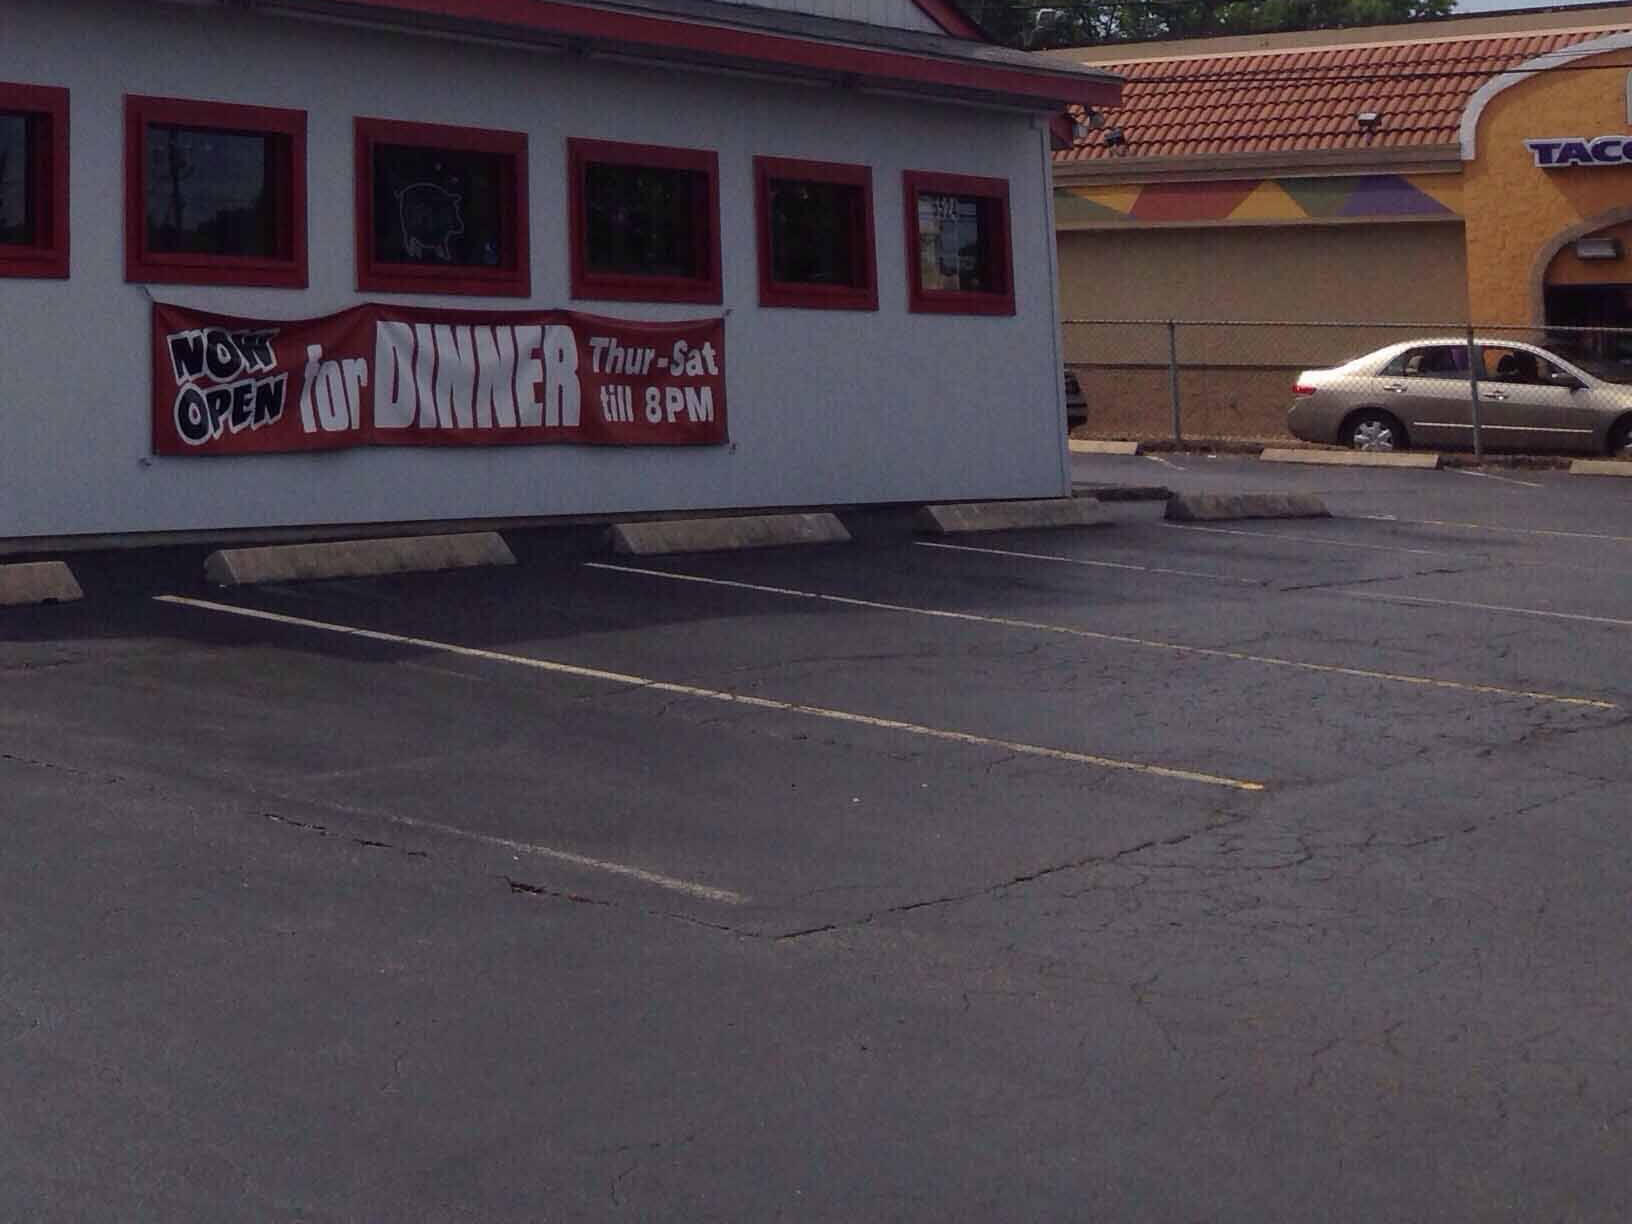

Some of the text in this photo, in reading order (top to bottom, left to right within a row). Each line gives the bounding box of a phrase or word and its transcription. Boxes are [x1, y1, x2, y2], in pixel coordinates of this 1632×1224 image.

[167, 326, 281, 385] NOW
[300, 320, 581, 433] for DINNER
[174, 372, 288, 445] OPEN
[600, 384, 634, 422] till
